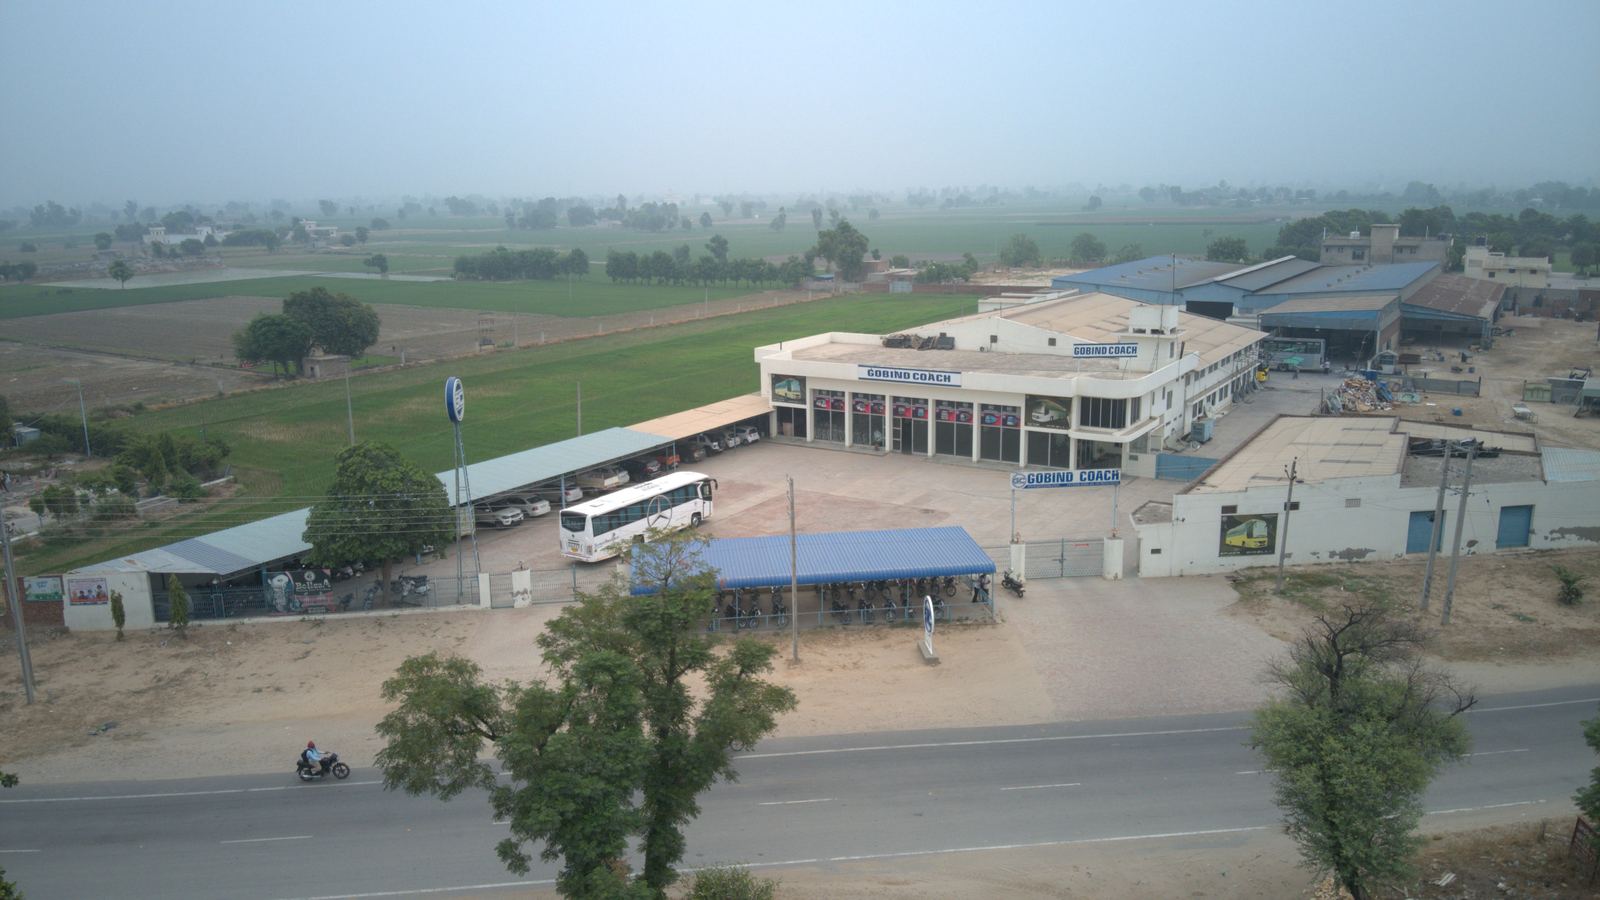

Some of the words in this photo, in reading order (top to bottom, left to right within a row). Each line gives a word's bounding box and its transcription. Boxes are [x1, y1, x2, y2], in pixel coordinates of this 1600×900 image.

[1073, 346, 1107, 355] GOBIND
[1108, 345, 1137, 355] COACH
[867, 368, 911, 380] GOBIND
[912, 372, 951, 383] COACH
[1027, 471, 1074, 484] GOBIND
[1079, 469, 1119, 482] COACH
